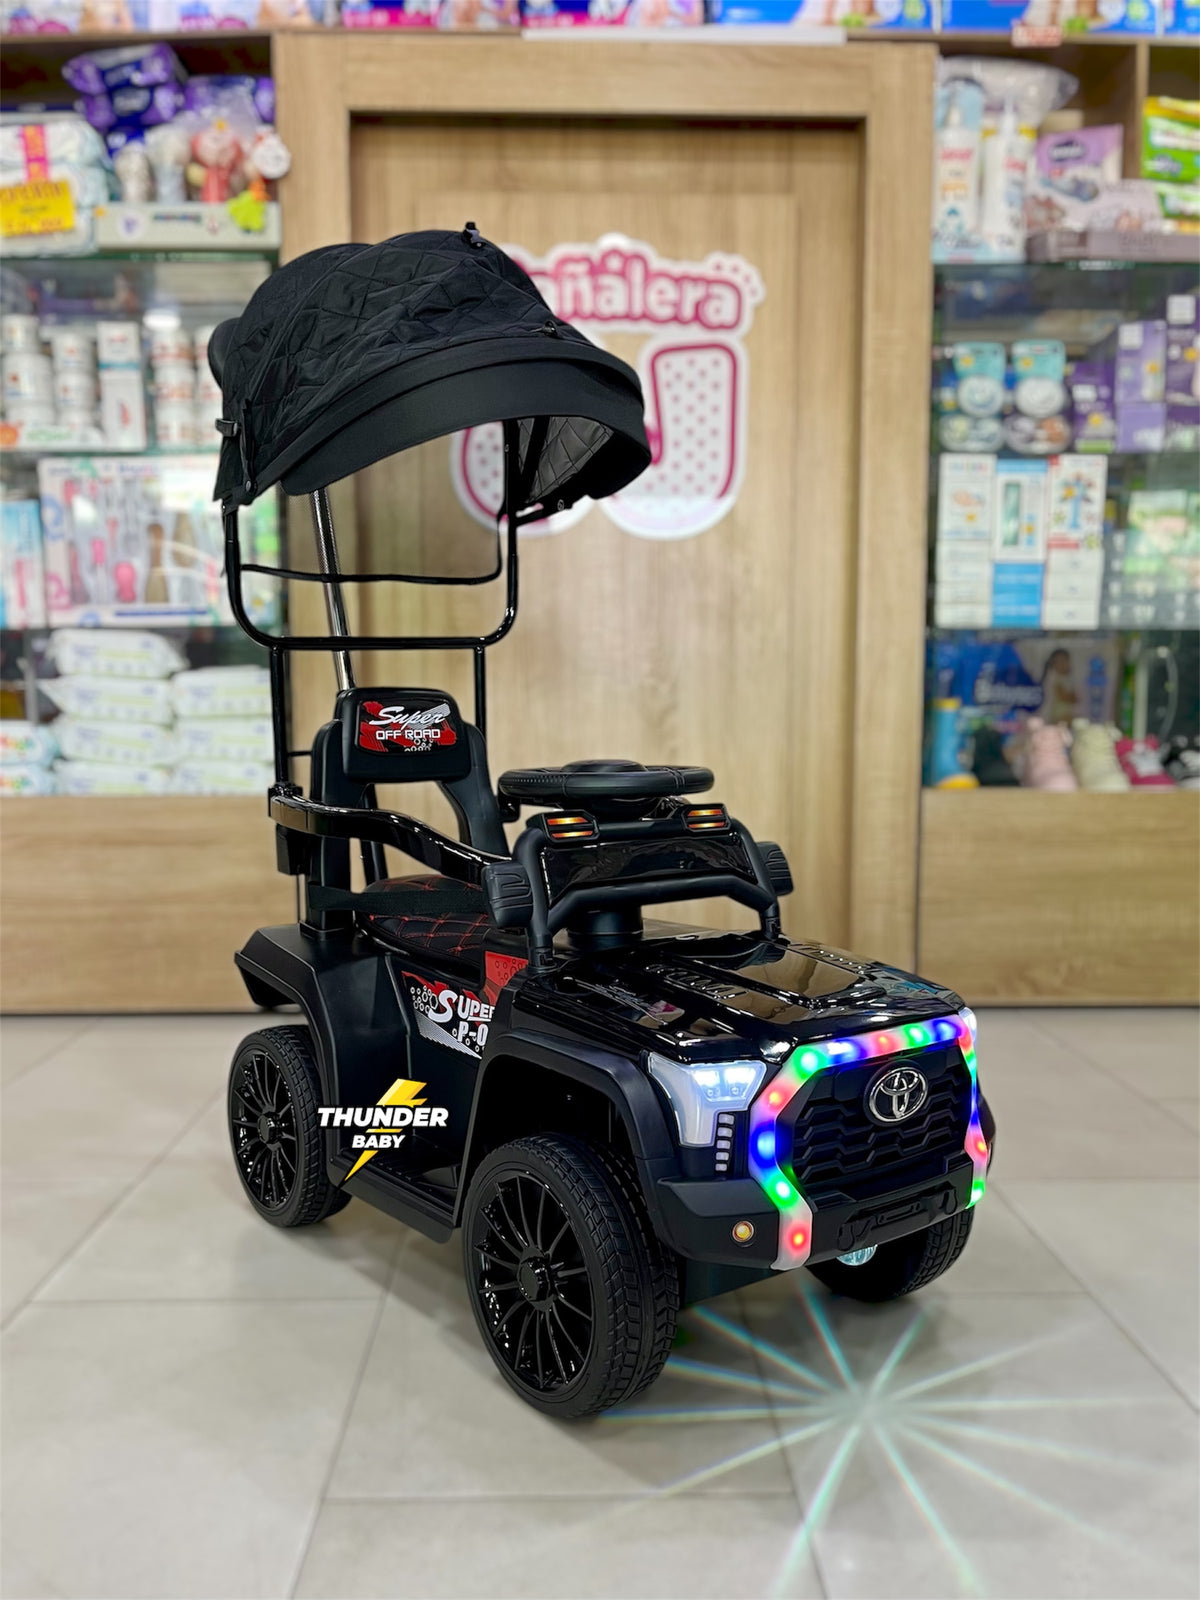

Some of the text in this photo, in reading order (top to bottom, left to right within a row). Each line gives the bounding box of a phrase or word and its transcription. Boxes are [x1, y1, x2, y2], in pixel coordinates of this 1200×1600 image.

[369, 706, 446, 730] Super
[376, 729, 441, 740] OFF ROAD
